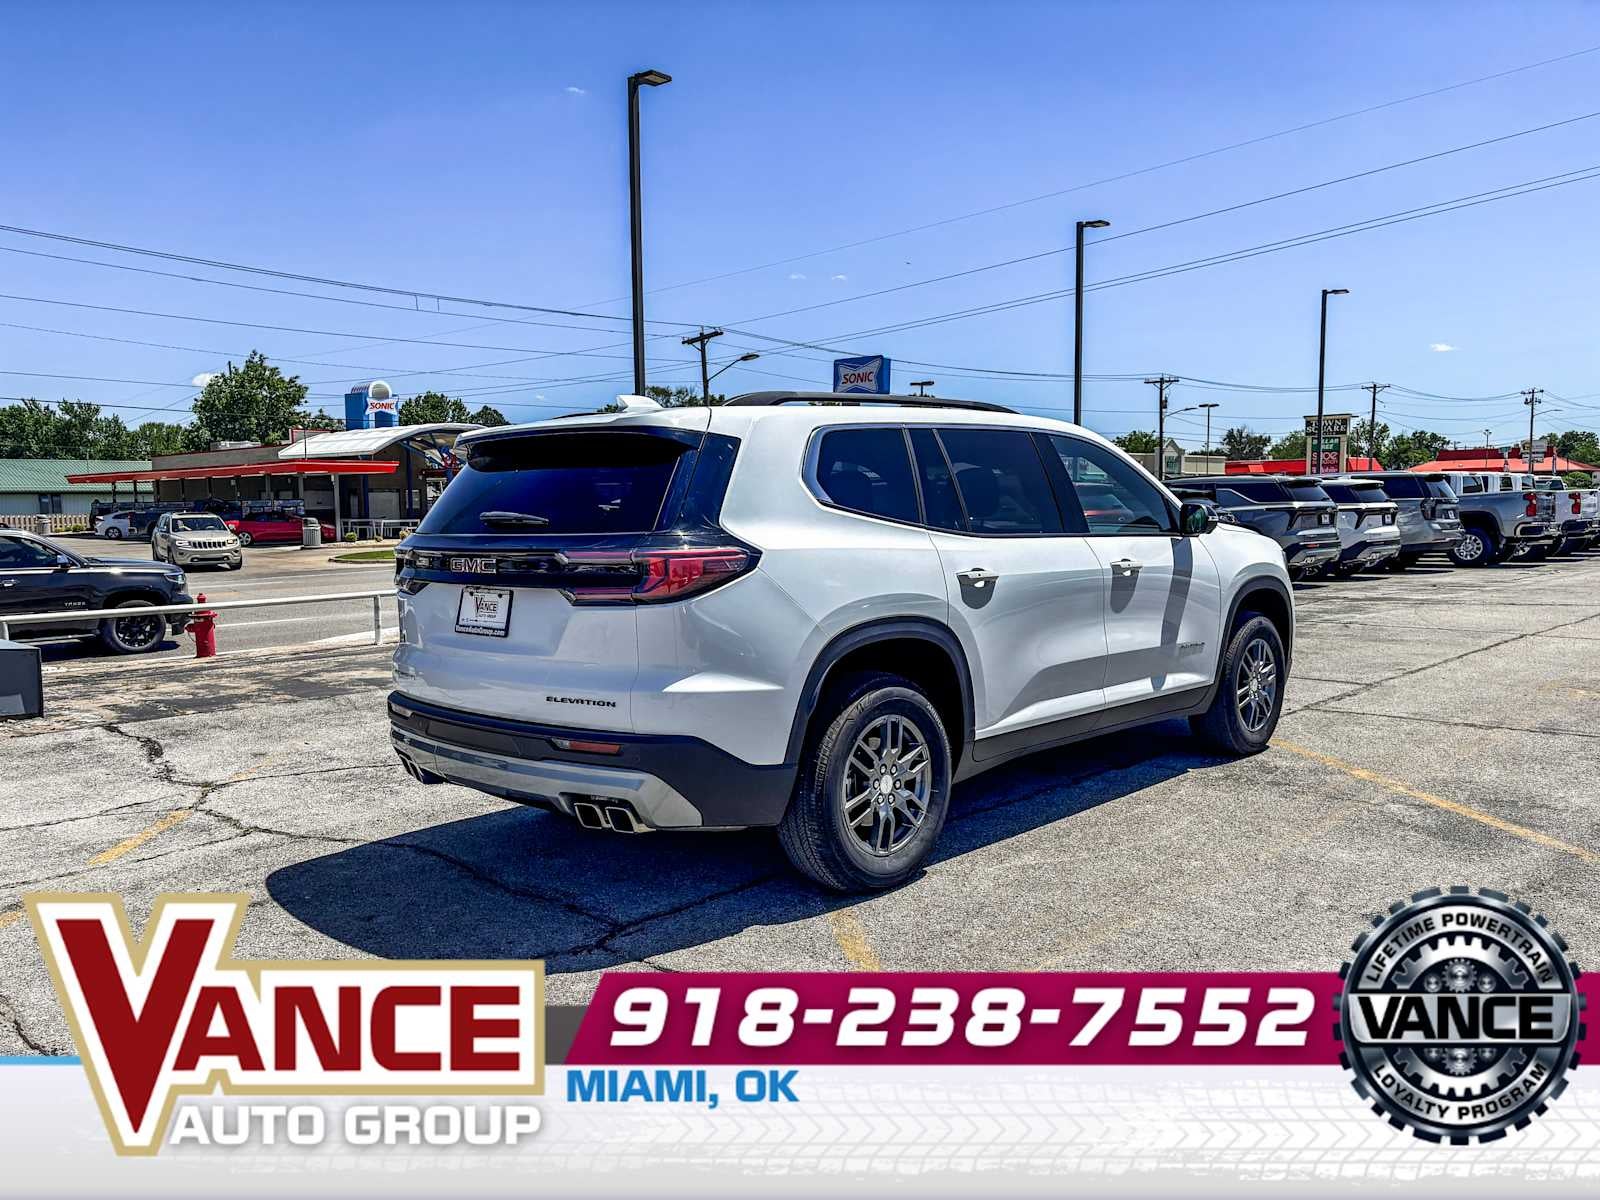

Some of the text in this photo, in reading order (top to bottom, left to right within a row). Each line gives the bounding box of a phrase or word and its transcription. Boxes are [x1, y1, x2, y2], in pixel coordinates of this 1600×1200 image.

[842, 371, 874, 384] SONIC
[369, 402, 395, 410] SONIC
[450, 557, 497, 574] GMC
[546, 696, 616, 708] ELEVATION
